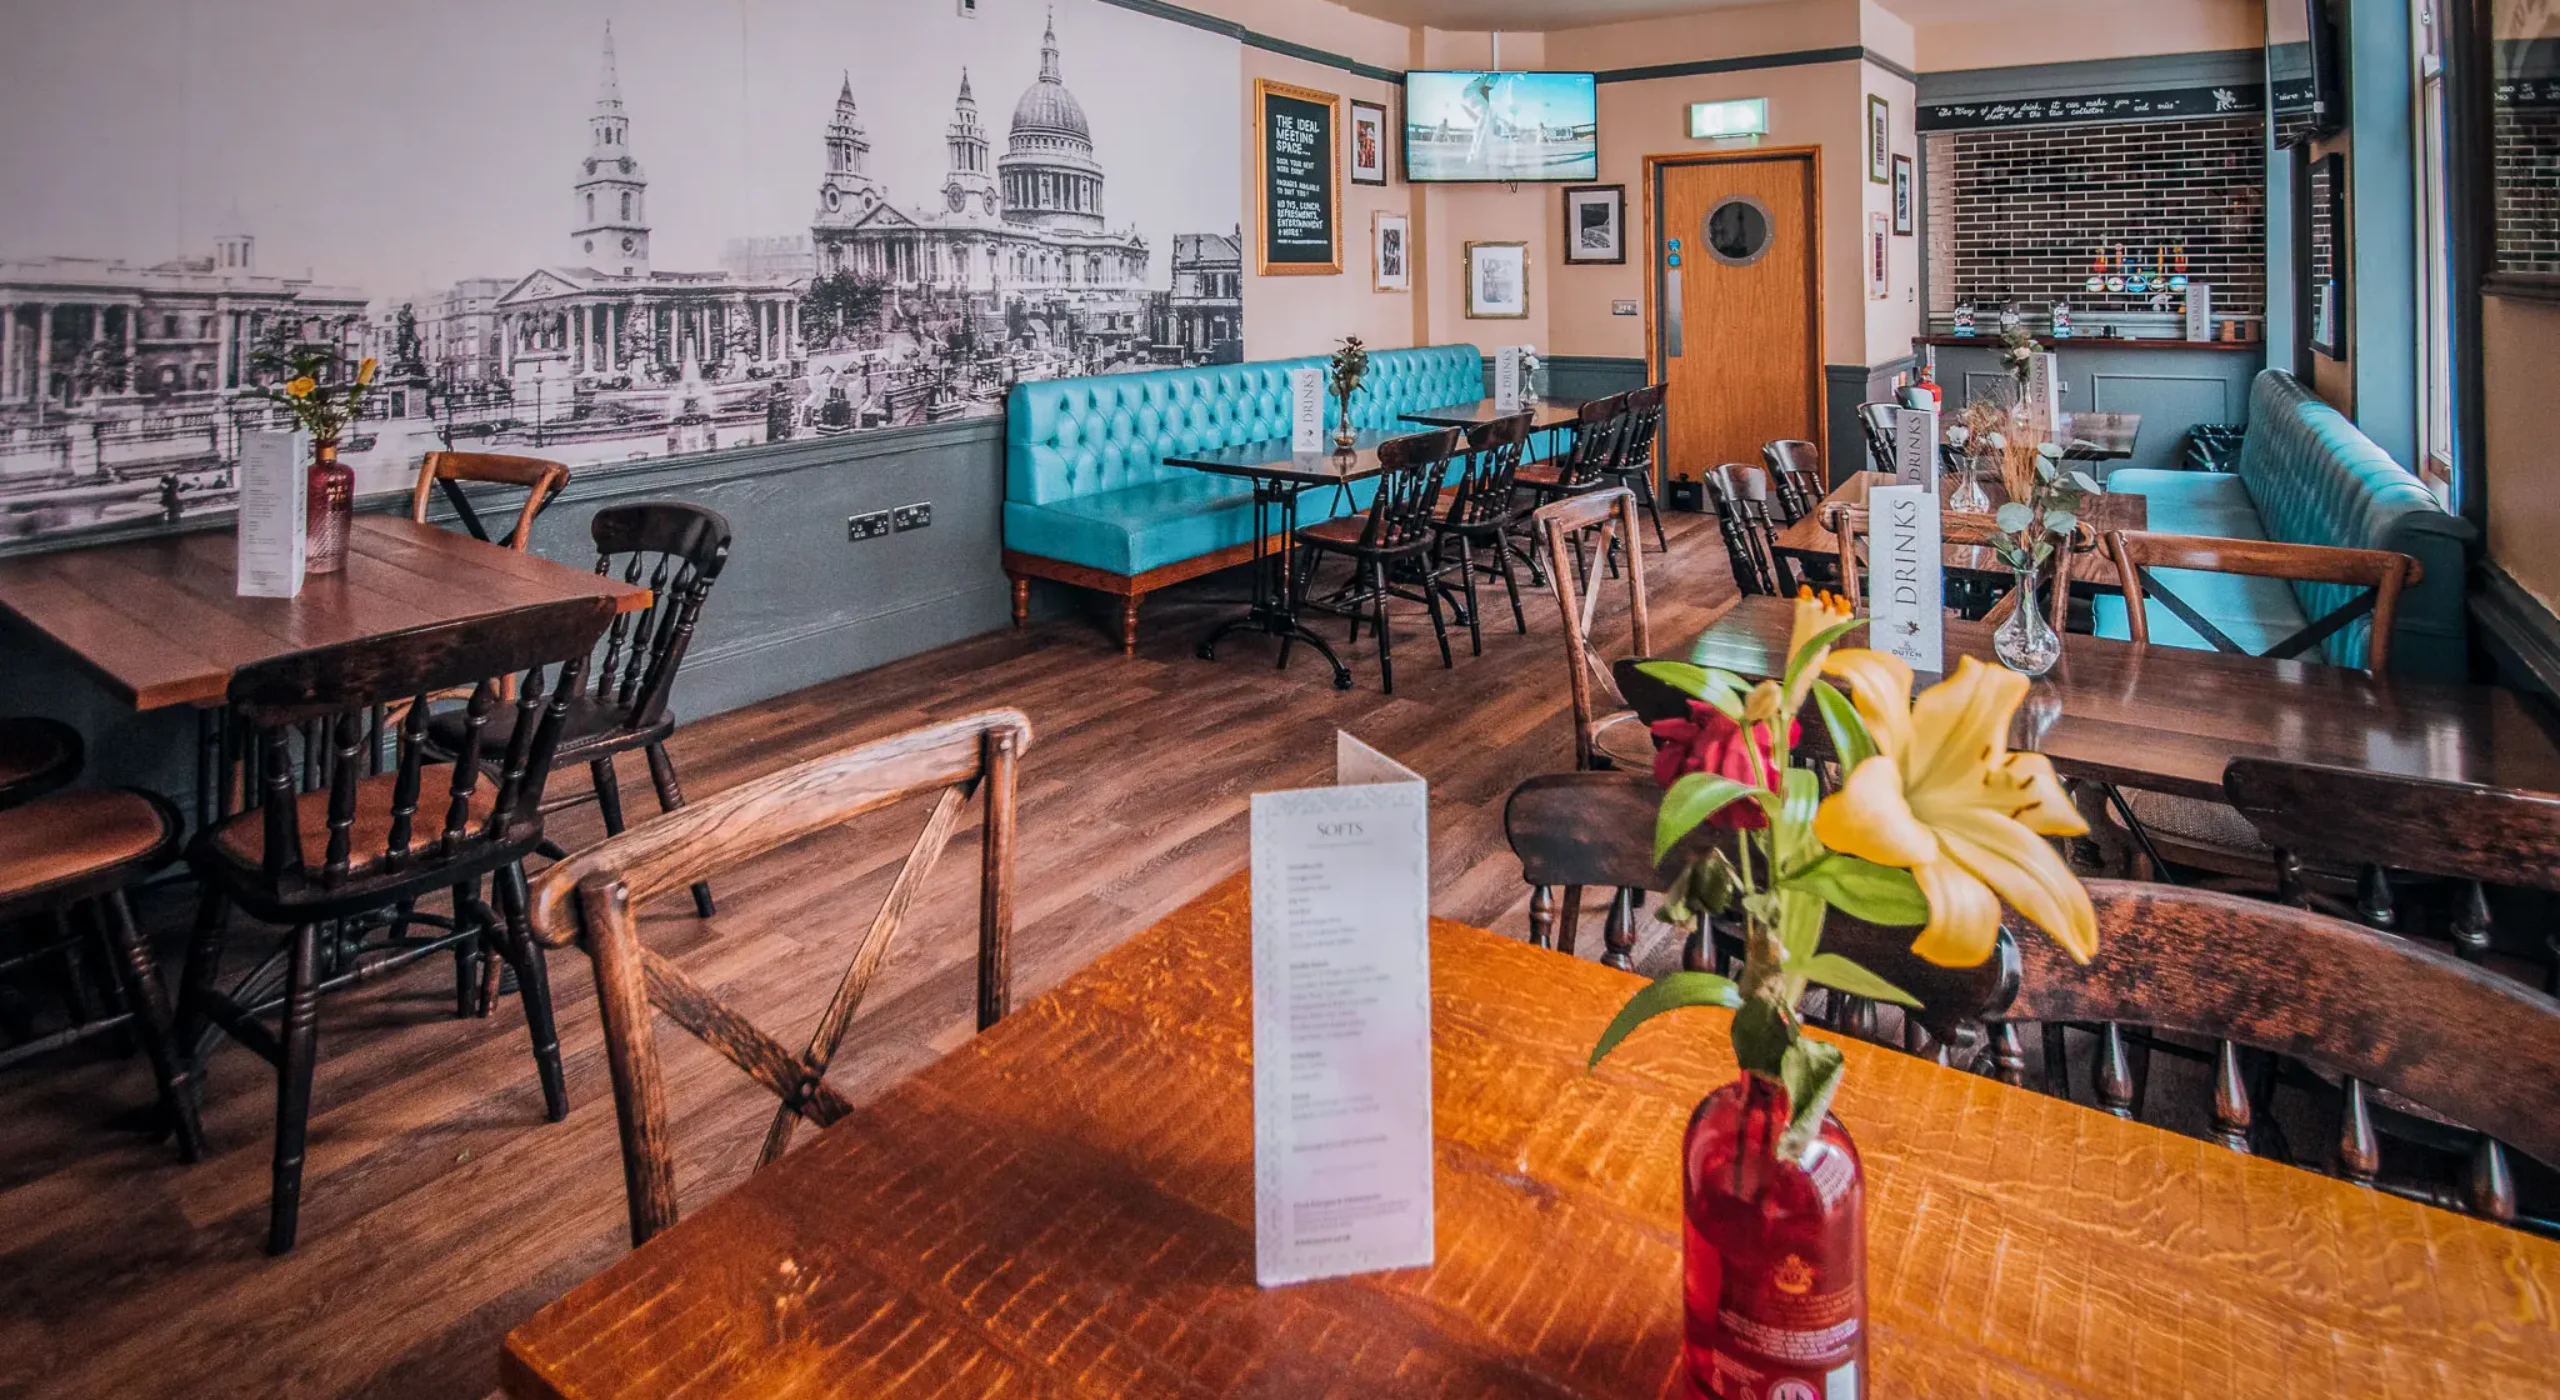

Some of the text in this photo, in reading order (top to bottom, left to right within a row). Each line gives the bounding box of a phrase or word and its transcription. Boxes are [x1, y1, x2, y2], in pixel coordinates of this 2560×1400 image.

[2114, 99, 2130, 108] you
[1276, 115, 1320, 133] THE IDEAL
[1276, 128, 1314, 144] MEETING
[2036, 356, 2046, 403] DRINKS
[1302, 374, 1314, 422] DRINKS
[1908, 416, 1921, 482] DRINKS
[1894, 499, 1918, 606] DRINKS
[1316, 821, 1364, 838] SOFTS
